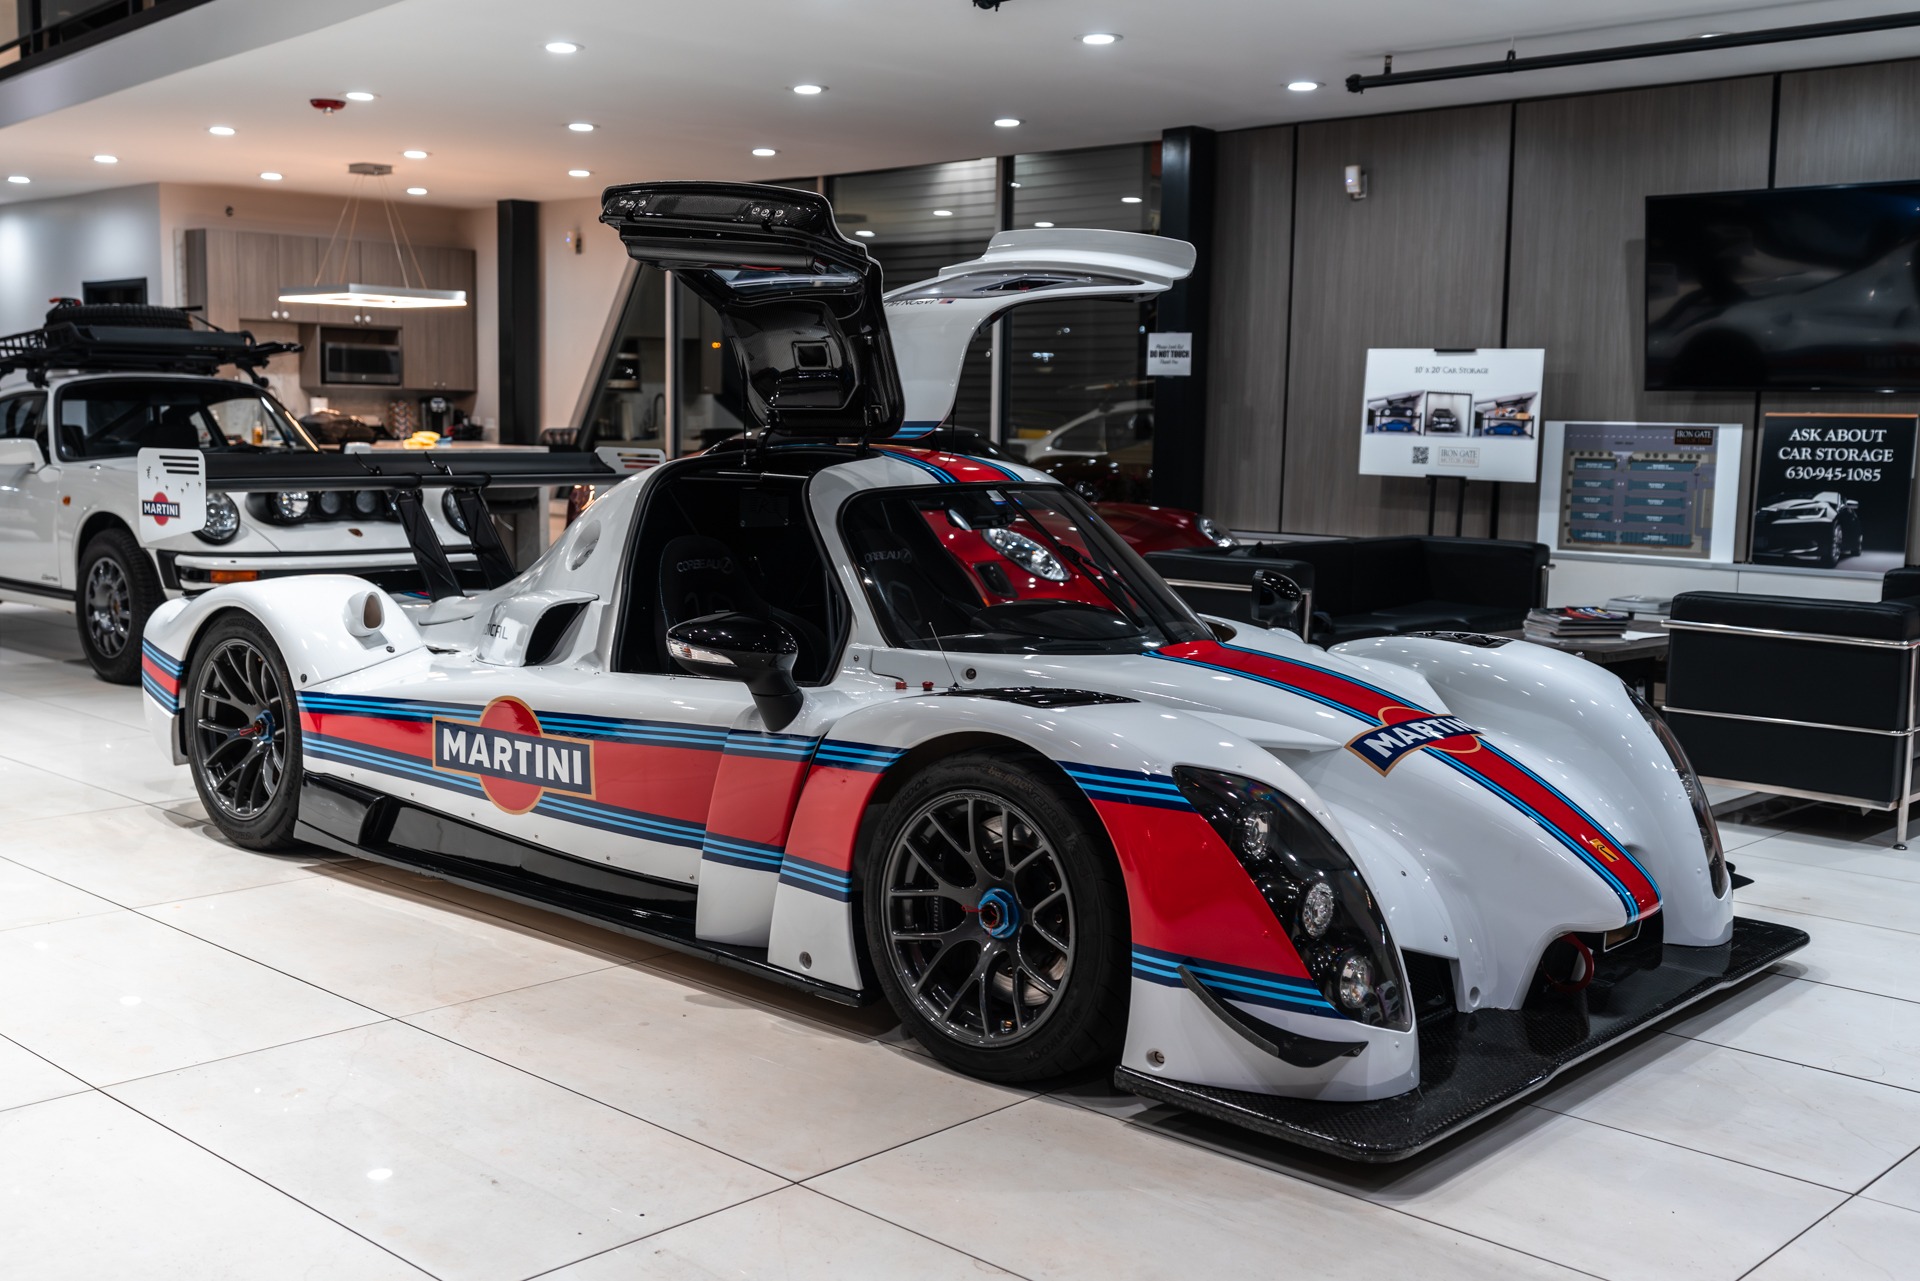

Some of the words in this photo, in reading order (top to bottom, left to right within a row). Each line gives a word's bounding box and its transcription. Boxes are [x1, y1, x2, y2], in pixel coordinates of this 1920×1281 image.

[1150, 350, 1157, 358] DO
[1159, 350, 1170, 358] NOT
[1171, 350, 1190, 358] TOUCH
[1676, 430, 1693, 438] IRON
[1694, 430, 1712, 439] GATE
[1789, 428, 1822, 442] ASK
[1824, 428, 1887, 443] ABOUT
[1441, 448, 1458, 457] IRON
[1460, 449, 1478, 459] GATE
[1778, 447, 1812, 461] CAR
[1815, 447, 1894, 462] STORAGE
[1785, 466, 1882, 482] 630-945-1085
[143, 502, 179, 516] MARTINI
[676, 558, 720, 573] CORBEAU
[443, 728, 583, 785] MARTINI
